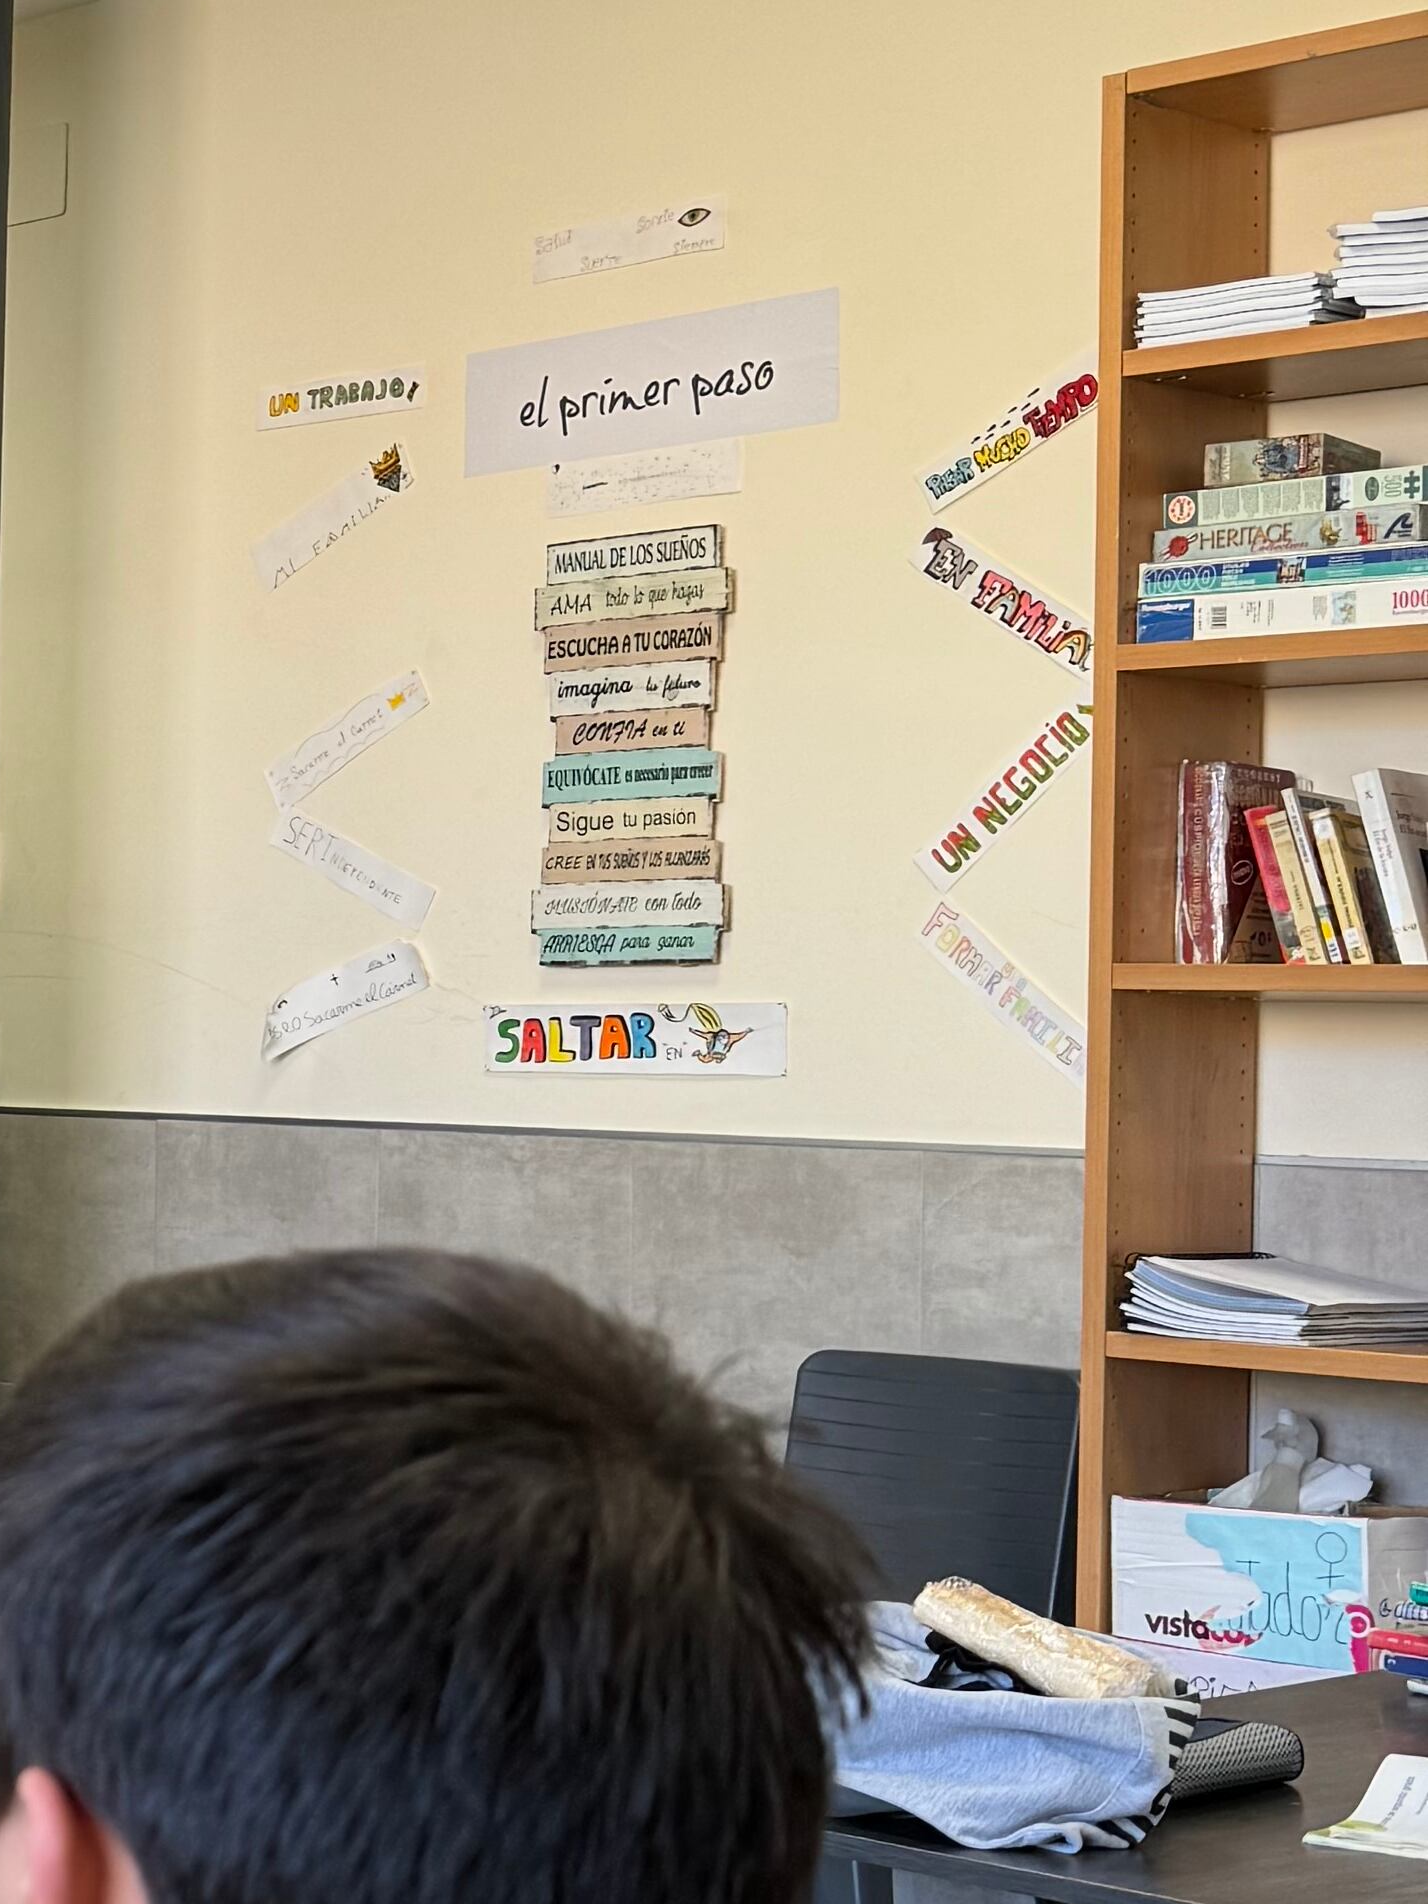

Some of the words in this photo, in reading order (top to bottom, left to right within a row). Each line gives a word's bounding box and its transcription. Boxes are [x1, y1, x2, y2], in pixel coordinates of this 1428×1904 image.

[268, 392, 300, 418] UN
[520, 376, 549, 427] el
[559, 377, 681, 437] primer
[691, 359, 776, 416] paso
[973, 426, 1031, 473] MUCHO
[1199, 521, 1293, 550] HERITAGE
[554, 550, 606, 575] MANUAL
[610, 546, 627, 569] DE
[630, 543, 654, 565] LOS
[656, 534, 707, 563] SUEÑOS
[1143, 563, 1217, 596] 1000
[550, 593, 593, 616] AMA
[605, 586, 629, 608] todo
[633, 585, 645, 604] lo
[648, 587, 669, 610] que
[671, 581, 705, 607] hagas
[547, 636, 619, 659] ESCUCHA
[622, 634, 631, 654] A
[633, 632, 651, 652] TU
[653, 622, 712, 650] CORAZÓN
[557, 677, 634, 708] imagina
[645, 675, 659, 693] tu
[661, 673, 702, 697] futuro
[652, 723, 668, 737] en
[673, 720, 686, 736] ti
[547, 765, 622, 791] EQUIVÓCATE
[634, 763, 669, 783] necesario
[670, 767, 689, 785] para
[556, 811, 614, 836] Sigue
[622, 811, 638, 828] tu
[642, 807, 696, 831] pasión
[545, 855, 584, 871] CREE
[931, 823, 981, 874] UN
[644, 897, 668, 912] con
[671, 891, 703, 912] todo
[543, 932, 617, 954] ARRIESGA
[620, 936, 651, 952] para
[657, 935, 695, 952] ganar
[494, 1012, 657, 1064] SALTAR
